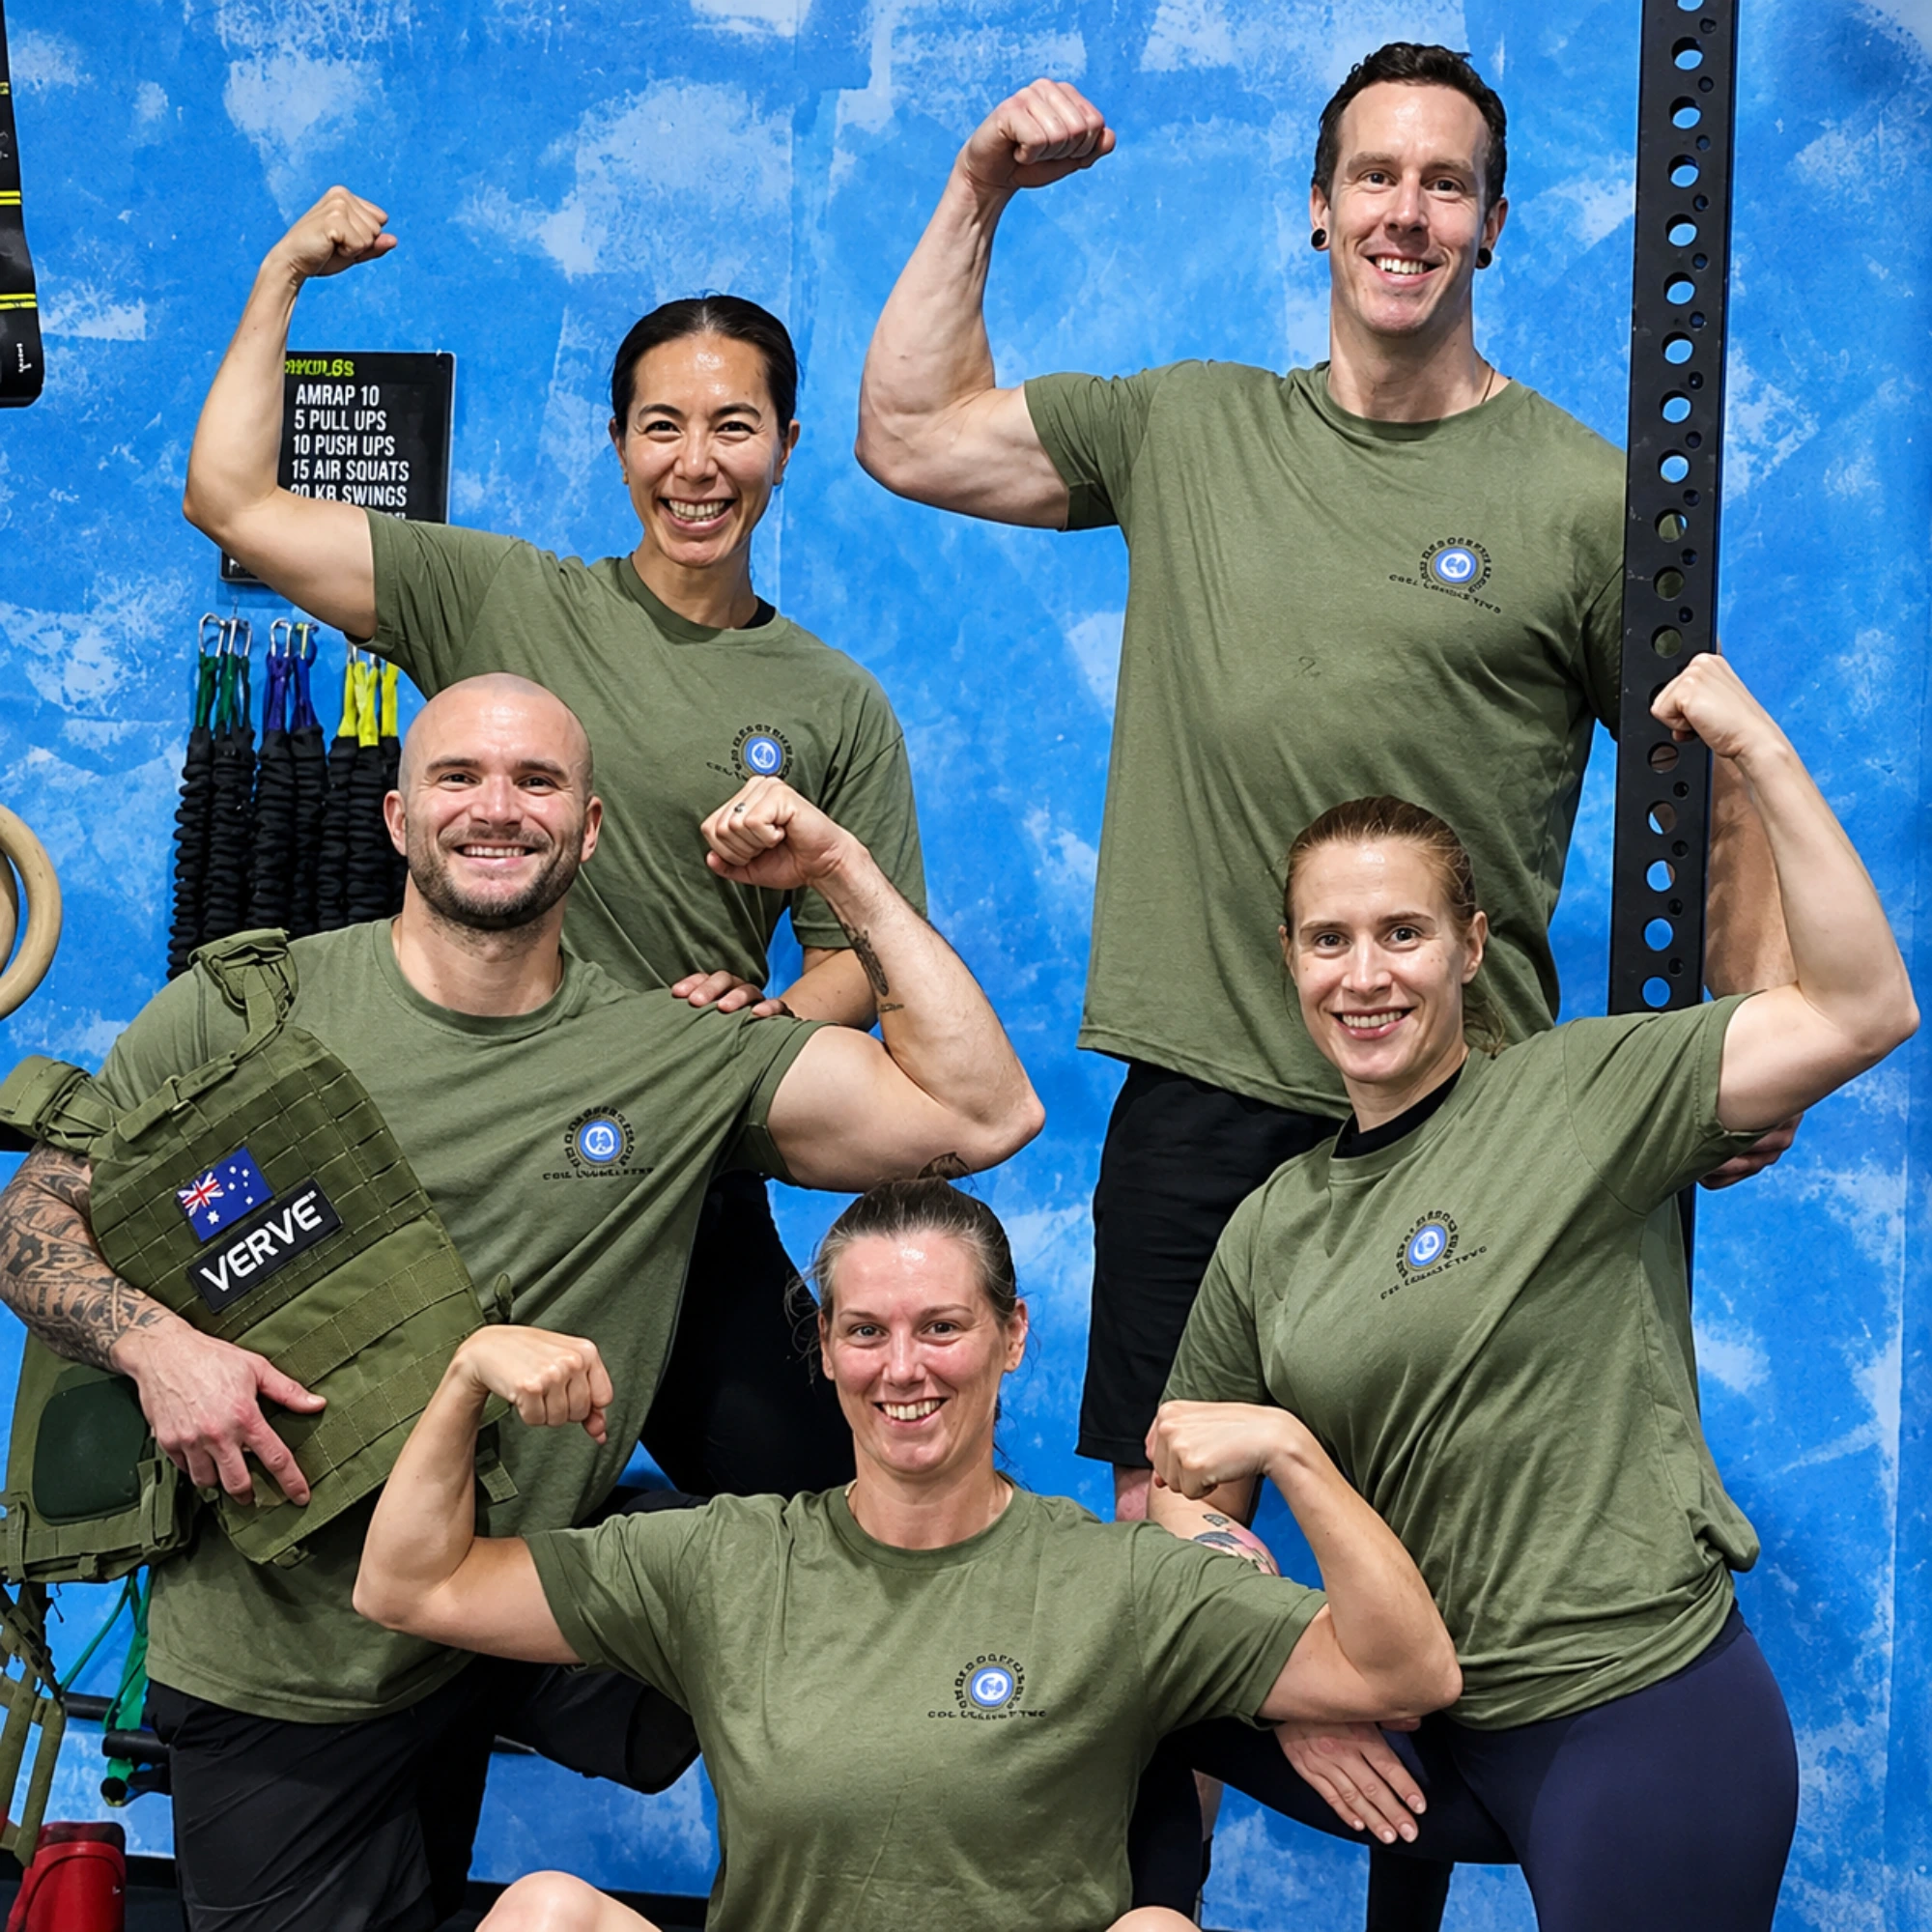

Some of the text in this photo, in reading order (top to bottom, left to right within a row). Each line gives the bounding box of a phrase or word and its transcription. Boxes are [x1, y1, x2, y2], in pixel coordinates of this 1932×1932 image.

[296, 384, 381, 407] AMRAP 10
[294, 409, 387, 432] 5 PULL UPS
[293, 434, 395, 457] 10 PUSH UPS
[292, 459, 410, 482] 15 AIR SQUATS
[341, 485, 408, 507] SWINGS
[199, 1189, 323, 1292] VERVE
